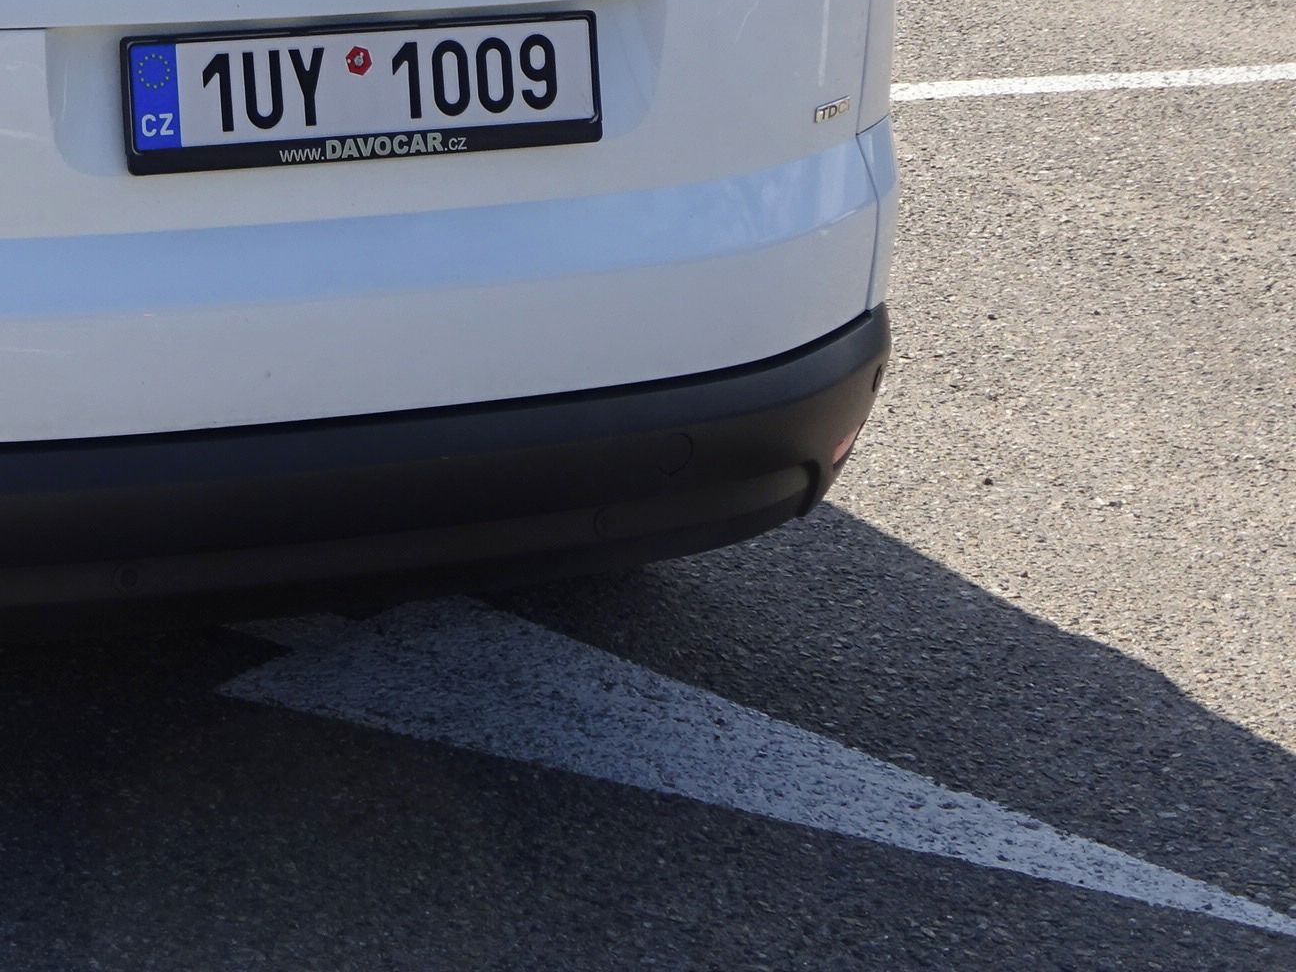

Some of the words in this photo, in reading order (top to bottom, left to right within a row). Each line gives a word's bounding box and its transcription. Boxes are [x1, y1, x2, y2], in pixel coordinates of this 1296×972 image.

[202, 47, 325, 133] 1UY
[391, 33, 557, 120] 1009
[141, 112, 175, 138] CZ
